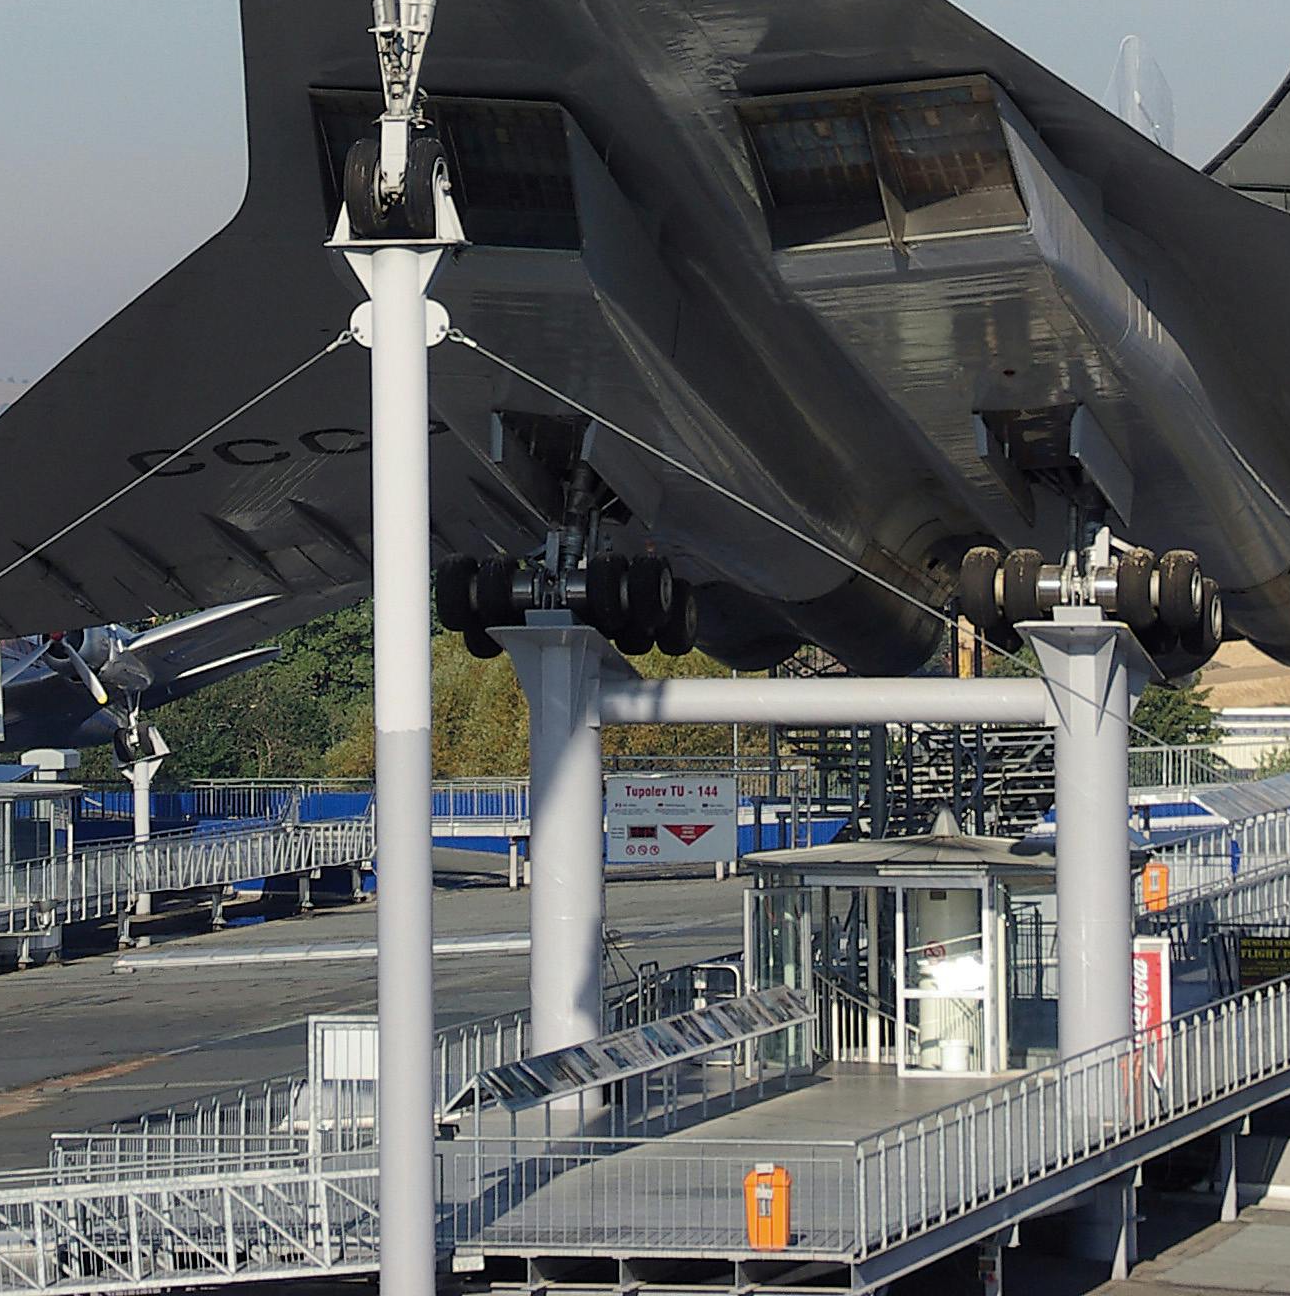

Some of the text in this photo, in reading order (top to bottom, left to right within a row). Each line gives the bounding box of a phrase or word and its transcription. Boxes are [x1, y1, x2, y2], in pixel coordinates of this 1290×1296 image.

[625, 785, 667, 799] Tupolev
[670, 785, 685, 797] TU
[698, 785, 718, 797] 144
[1240, 949, 1280, 959] FLIGHT
